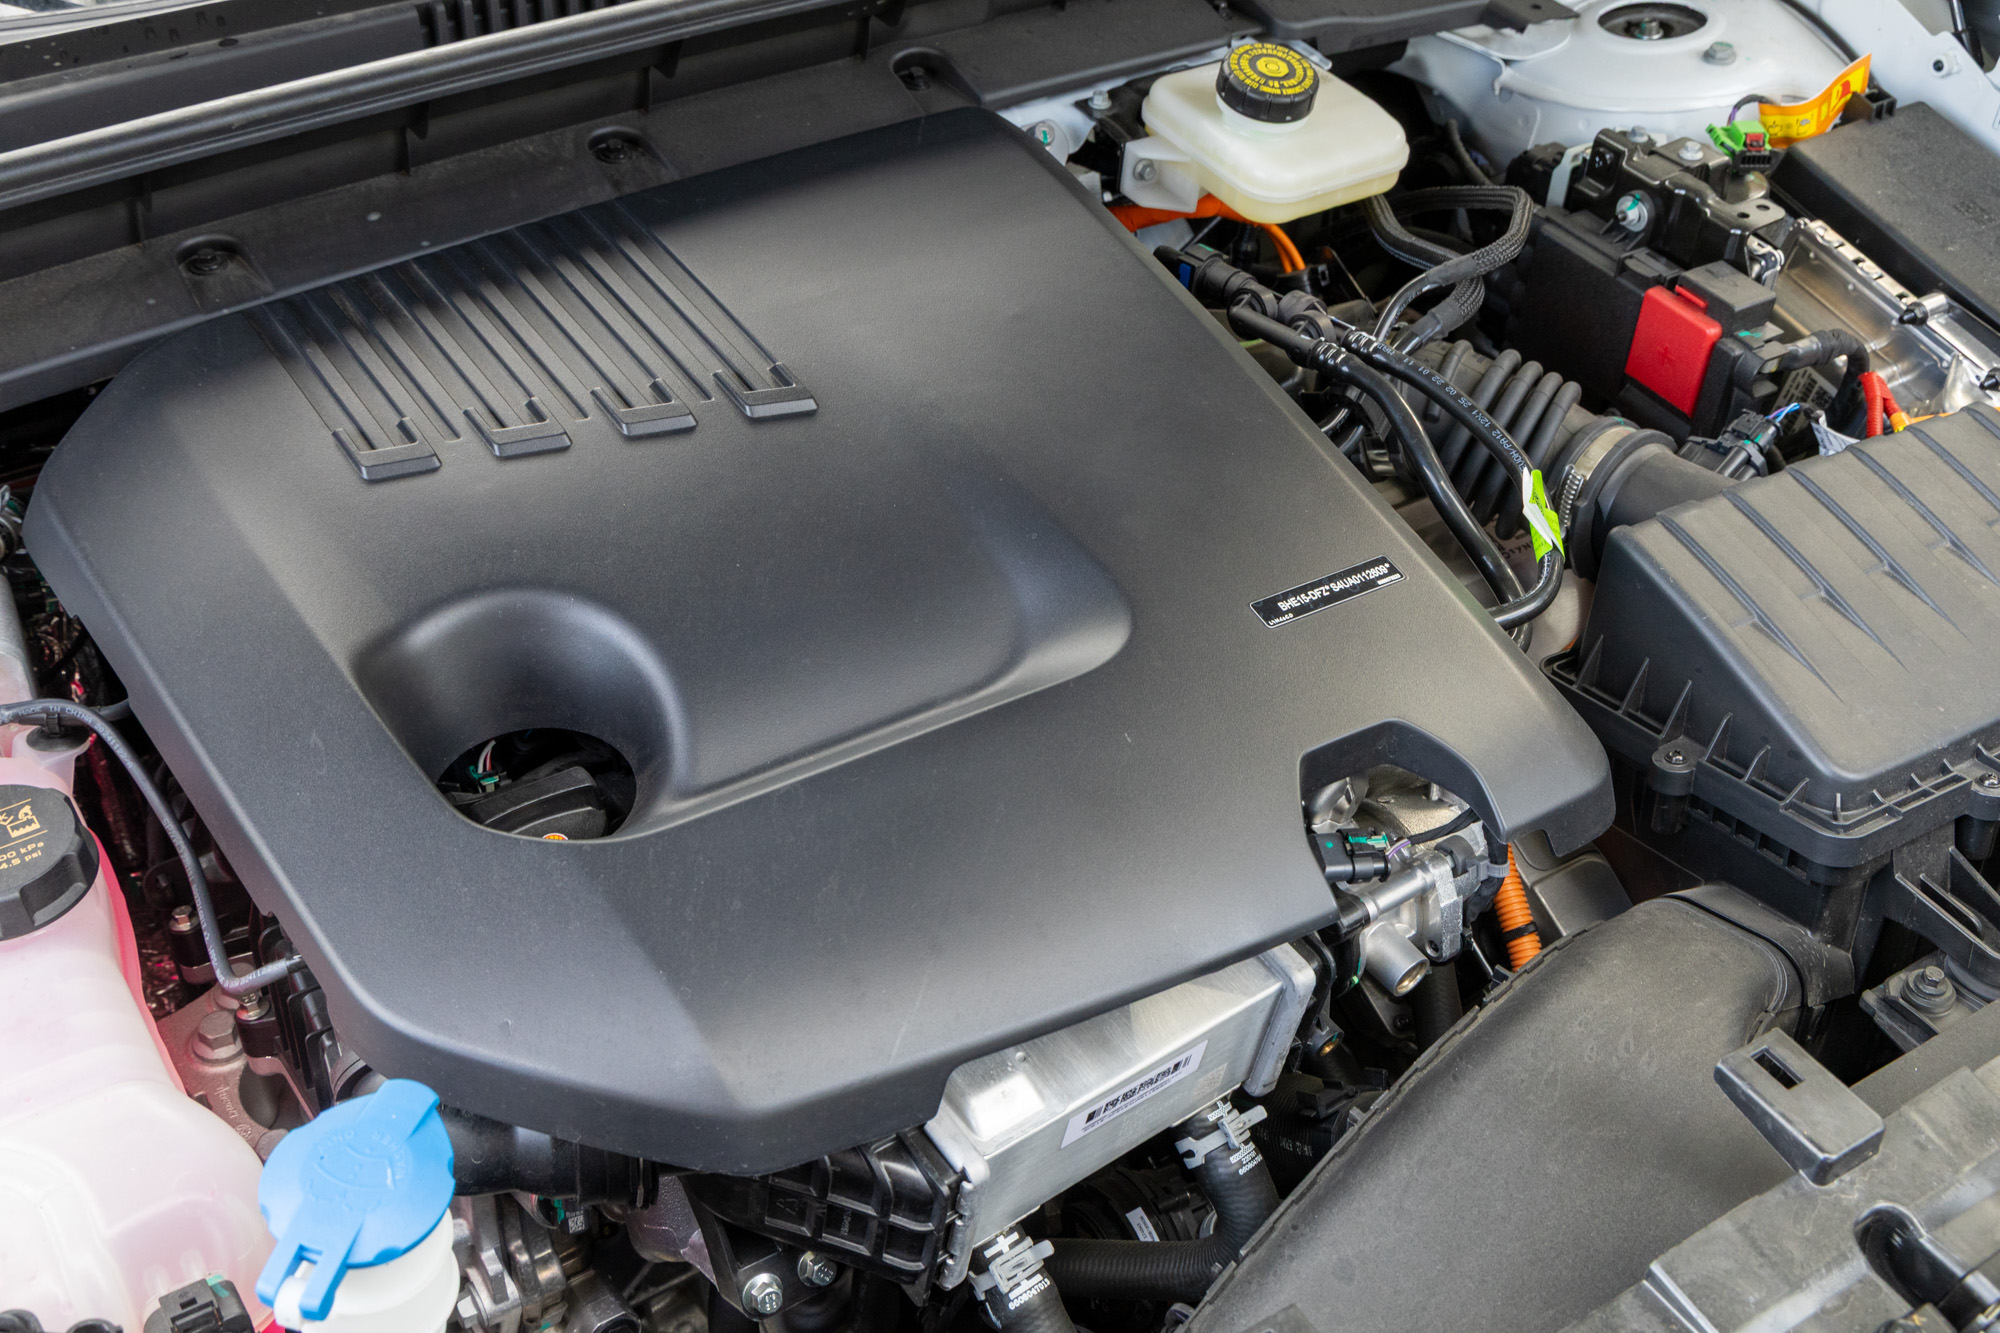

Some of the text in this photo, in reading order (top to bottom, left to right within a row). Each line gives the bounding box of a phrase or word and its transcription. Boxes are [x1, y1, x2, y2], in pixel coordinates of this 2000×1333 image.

[1431, 376, 1445, 386] 22
[1458, 397, 1472, 408] 25
[65, 707, 92, 724] CHINA
[20, 841, 44, 854] kPa
[25, 849, 42, 862] psi
